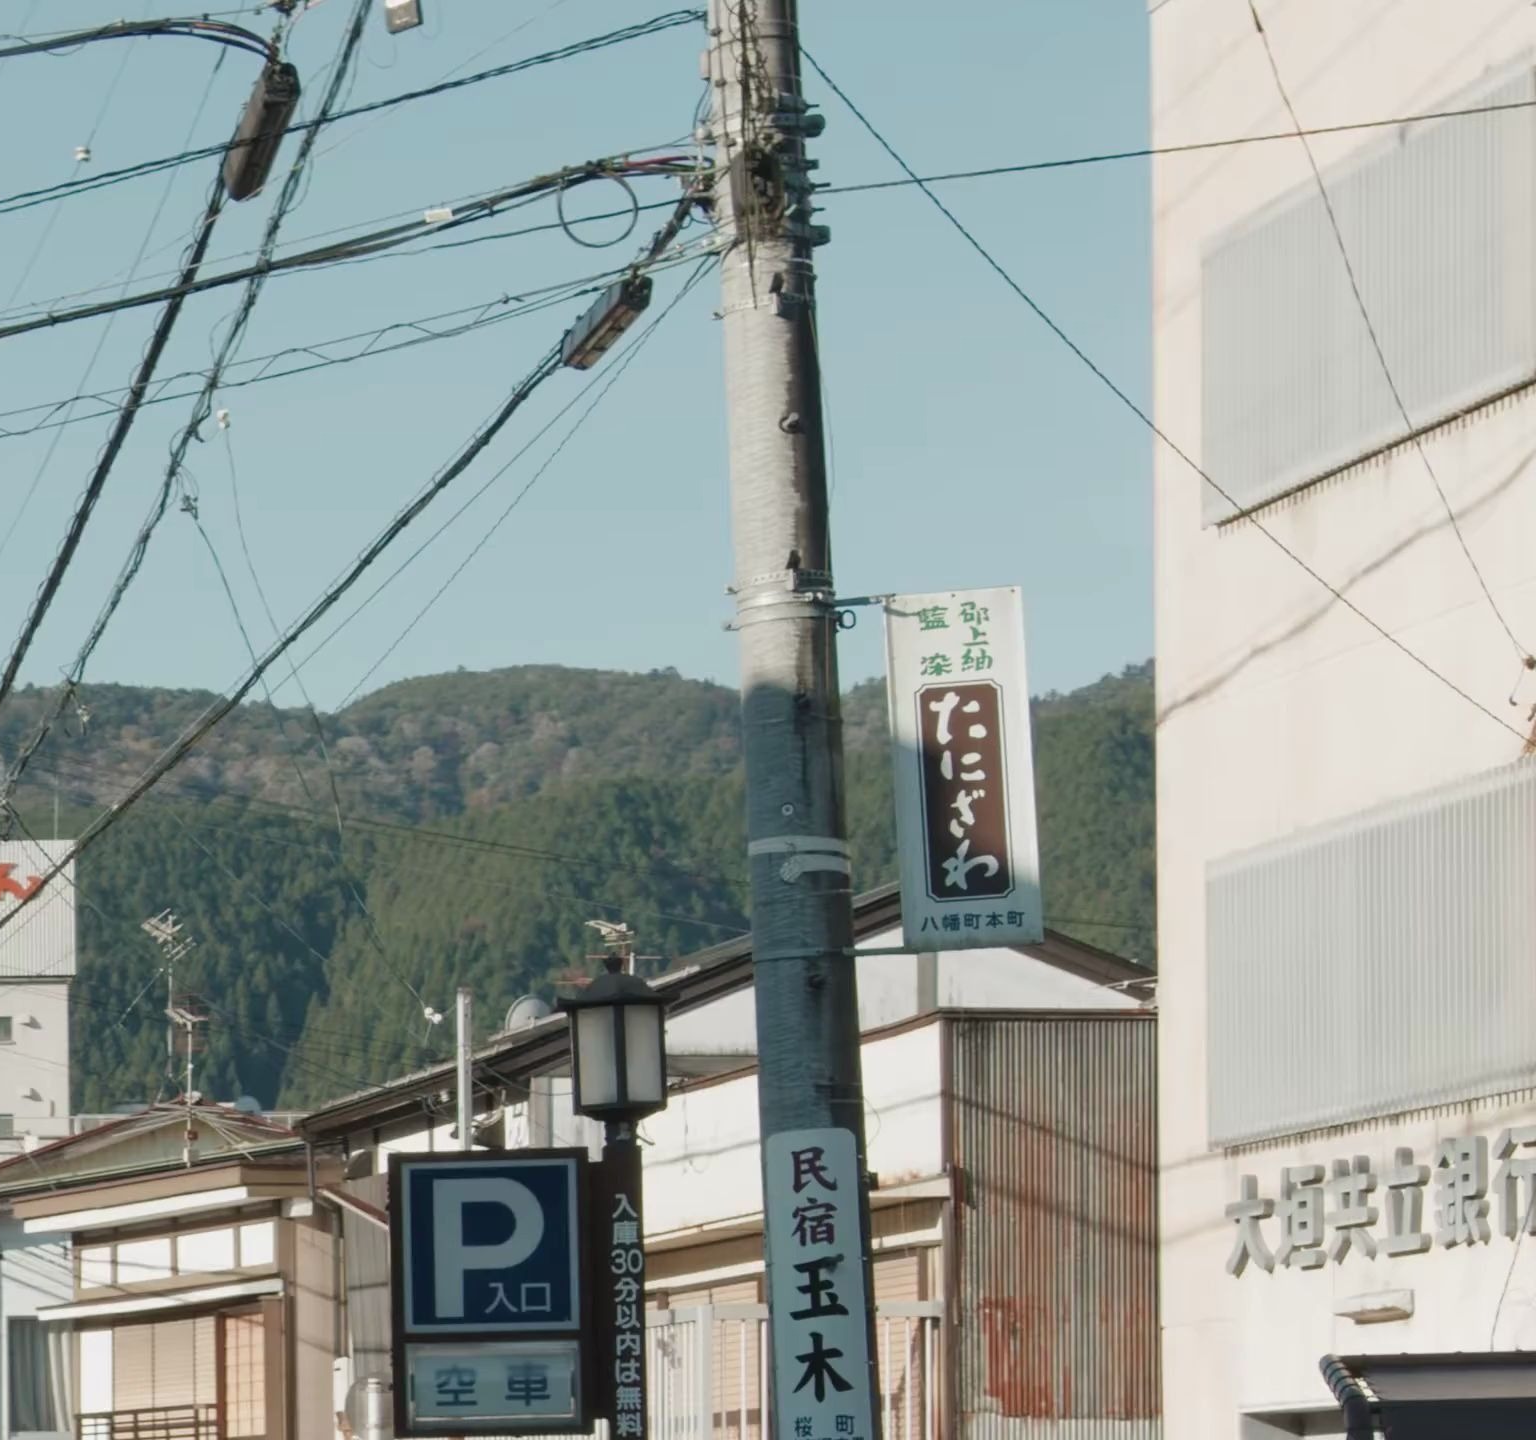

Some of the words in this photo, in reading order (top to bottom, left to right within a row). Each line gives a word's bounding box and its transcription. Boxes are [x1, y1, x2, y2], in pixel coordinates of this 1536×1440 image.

[918, 605, 953, 676] 藍染
[928, 691, 999, 889] たにざわ
[921, 911, 1025, 933] 八幡町本町
[1224, 1127, 1536, 1279] 大垣共立銀行
[432, 1177, 545, 1319] P
[484, 1281, 552, 1315] 入口
[435, 1363, 551, 1408] 空車
